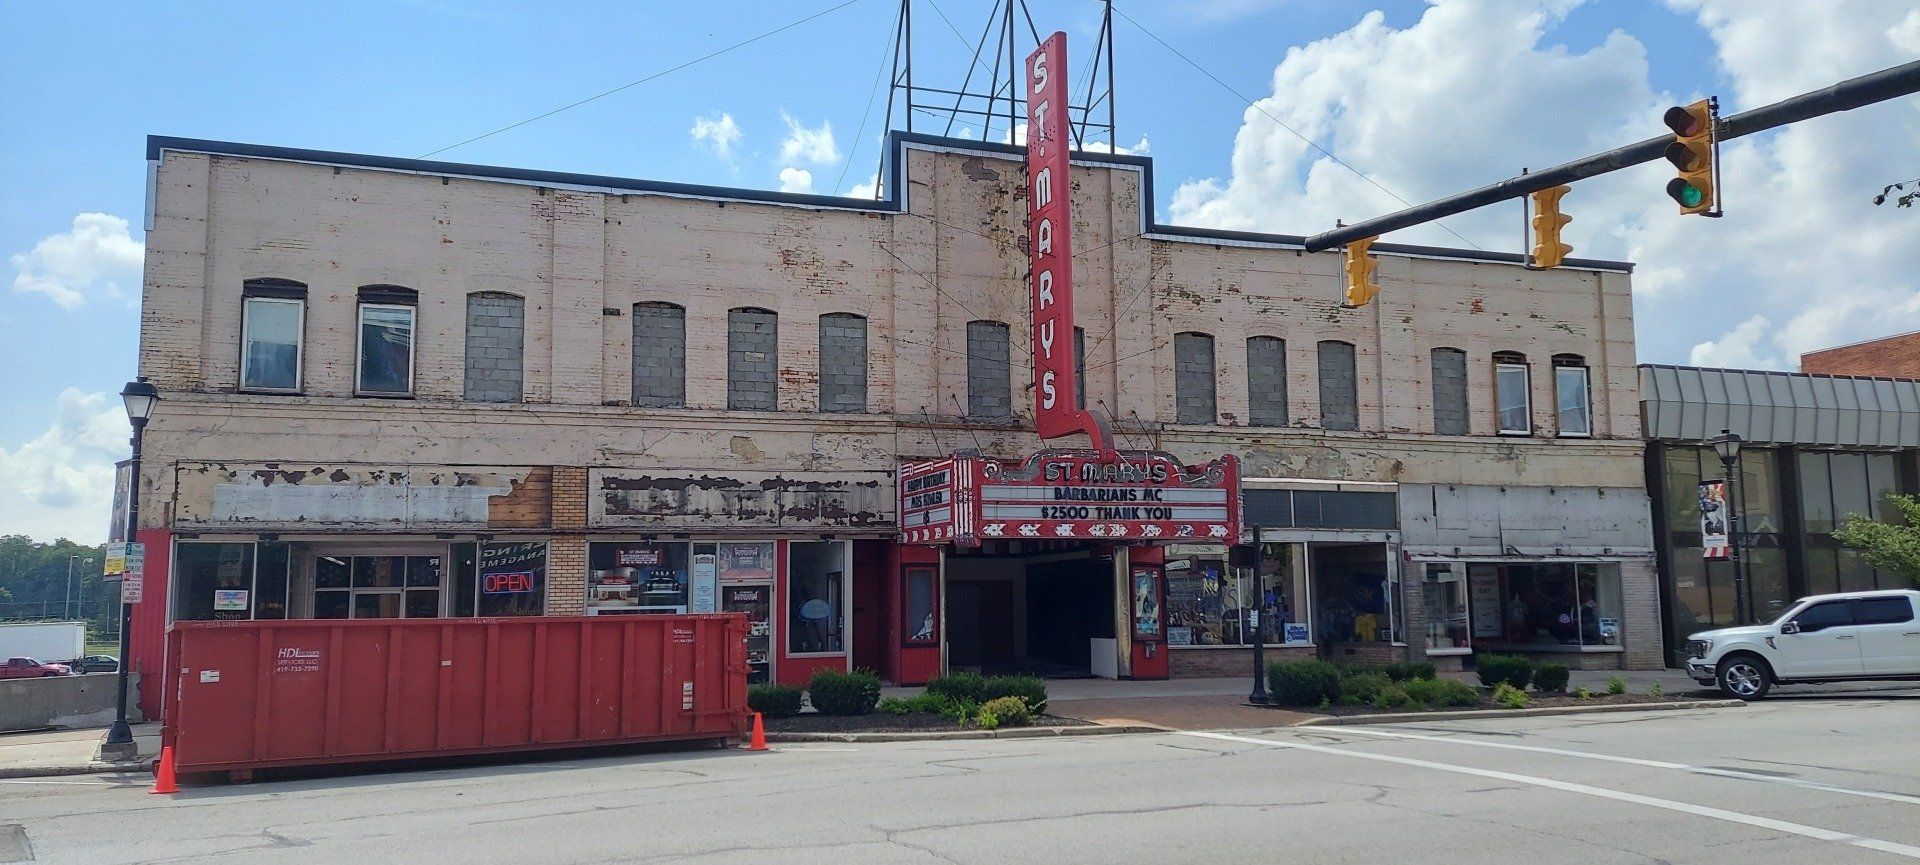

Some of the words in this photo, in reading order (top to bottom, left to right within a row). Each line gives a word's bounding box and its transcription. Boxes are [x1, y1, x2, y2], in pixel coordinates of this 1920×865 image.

[1035, 166, 1056, 410] MARYS
[1082, 462, 1168, 482] MARYS
[1054, 486, 1137, 501] BARBARIANS
[1143, 488, 1163, 502] MC
[1041, 506, 1089, 519] $2500
[1095, 506, 1140, 520] THANK
[1144, 507, 1173, 520] YOU
[485, 574, 532, 592] OPEN
